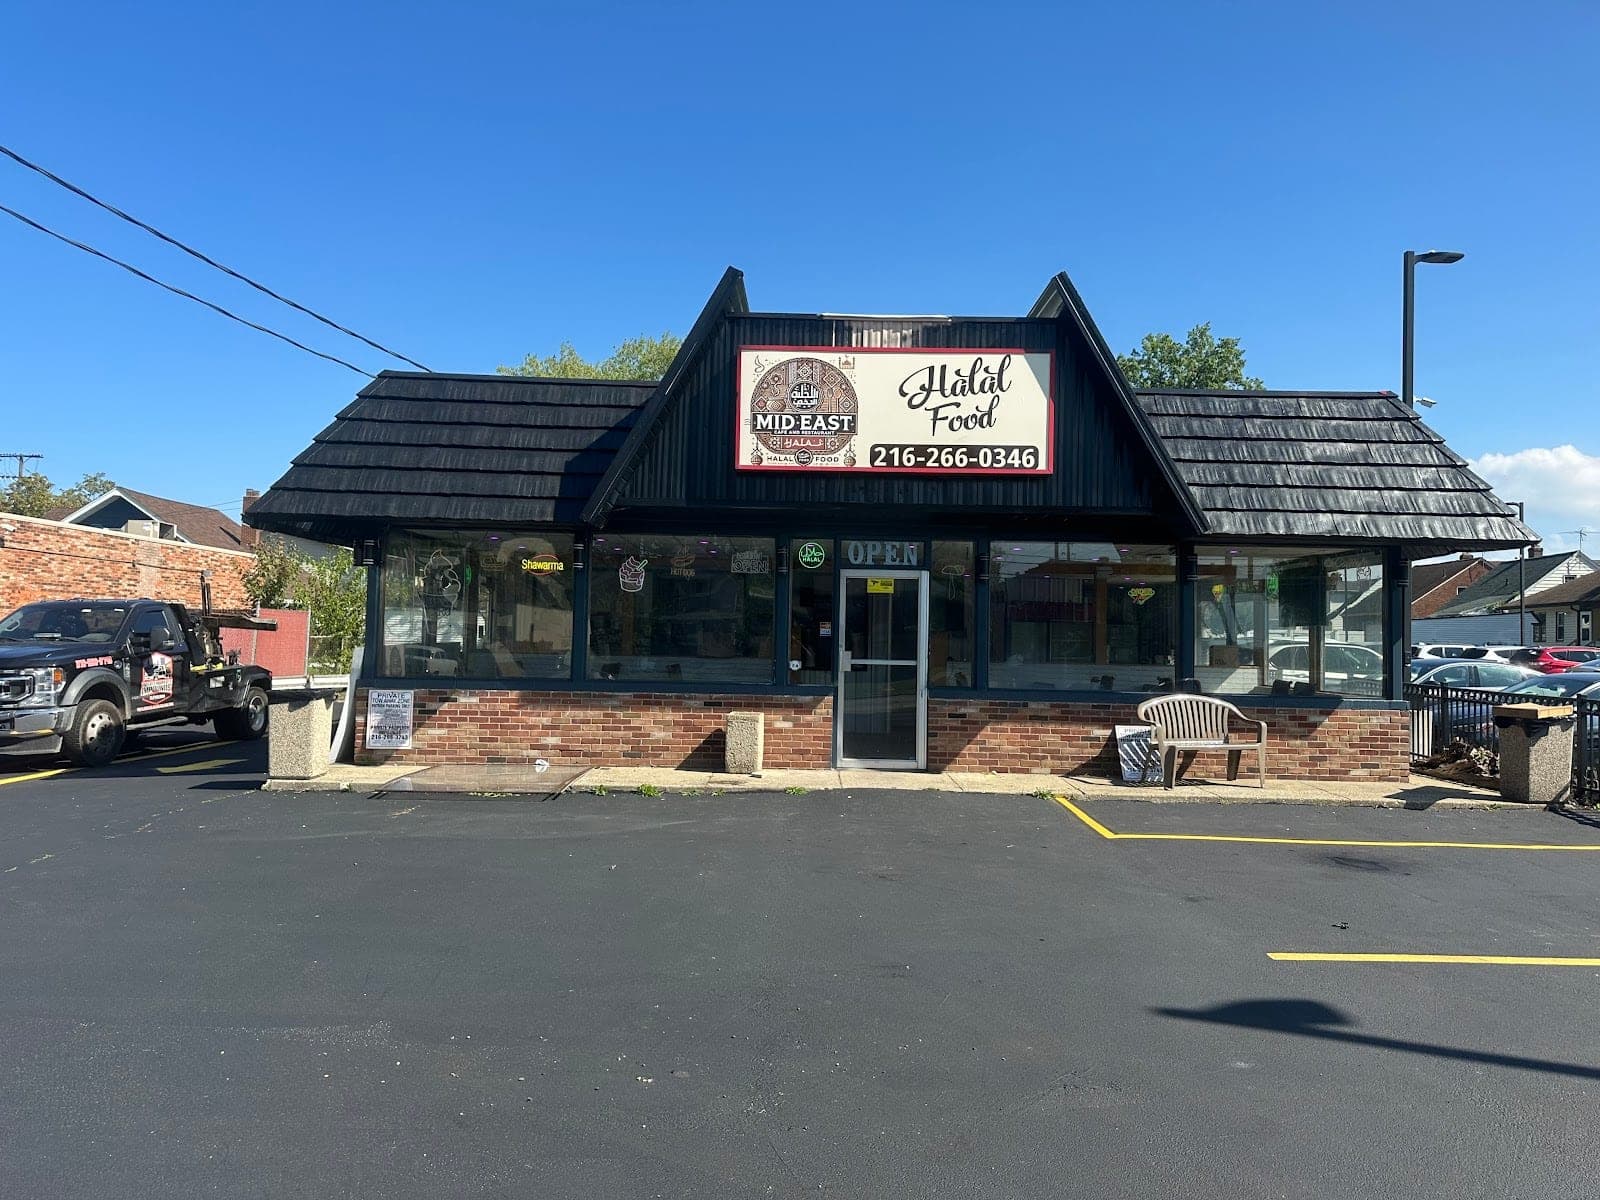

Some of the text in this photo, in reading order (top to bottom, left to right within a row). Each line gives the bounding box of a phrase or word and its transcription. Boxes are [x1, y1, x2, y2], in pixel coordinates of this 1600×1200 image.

[899, 353, 1012, 409] Halal
[755, 414, 853, 431] MID EAST
[924, 395, 1000, 436] Food
[873, 446, 1036, 468] 216-266-0346
[521, 558, 564, 571] Shawarma
[847, 541, 918, 566] OPEN
